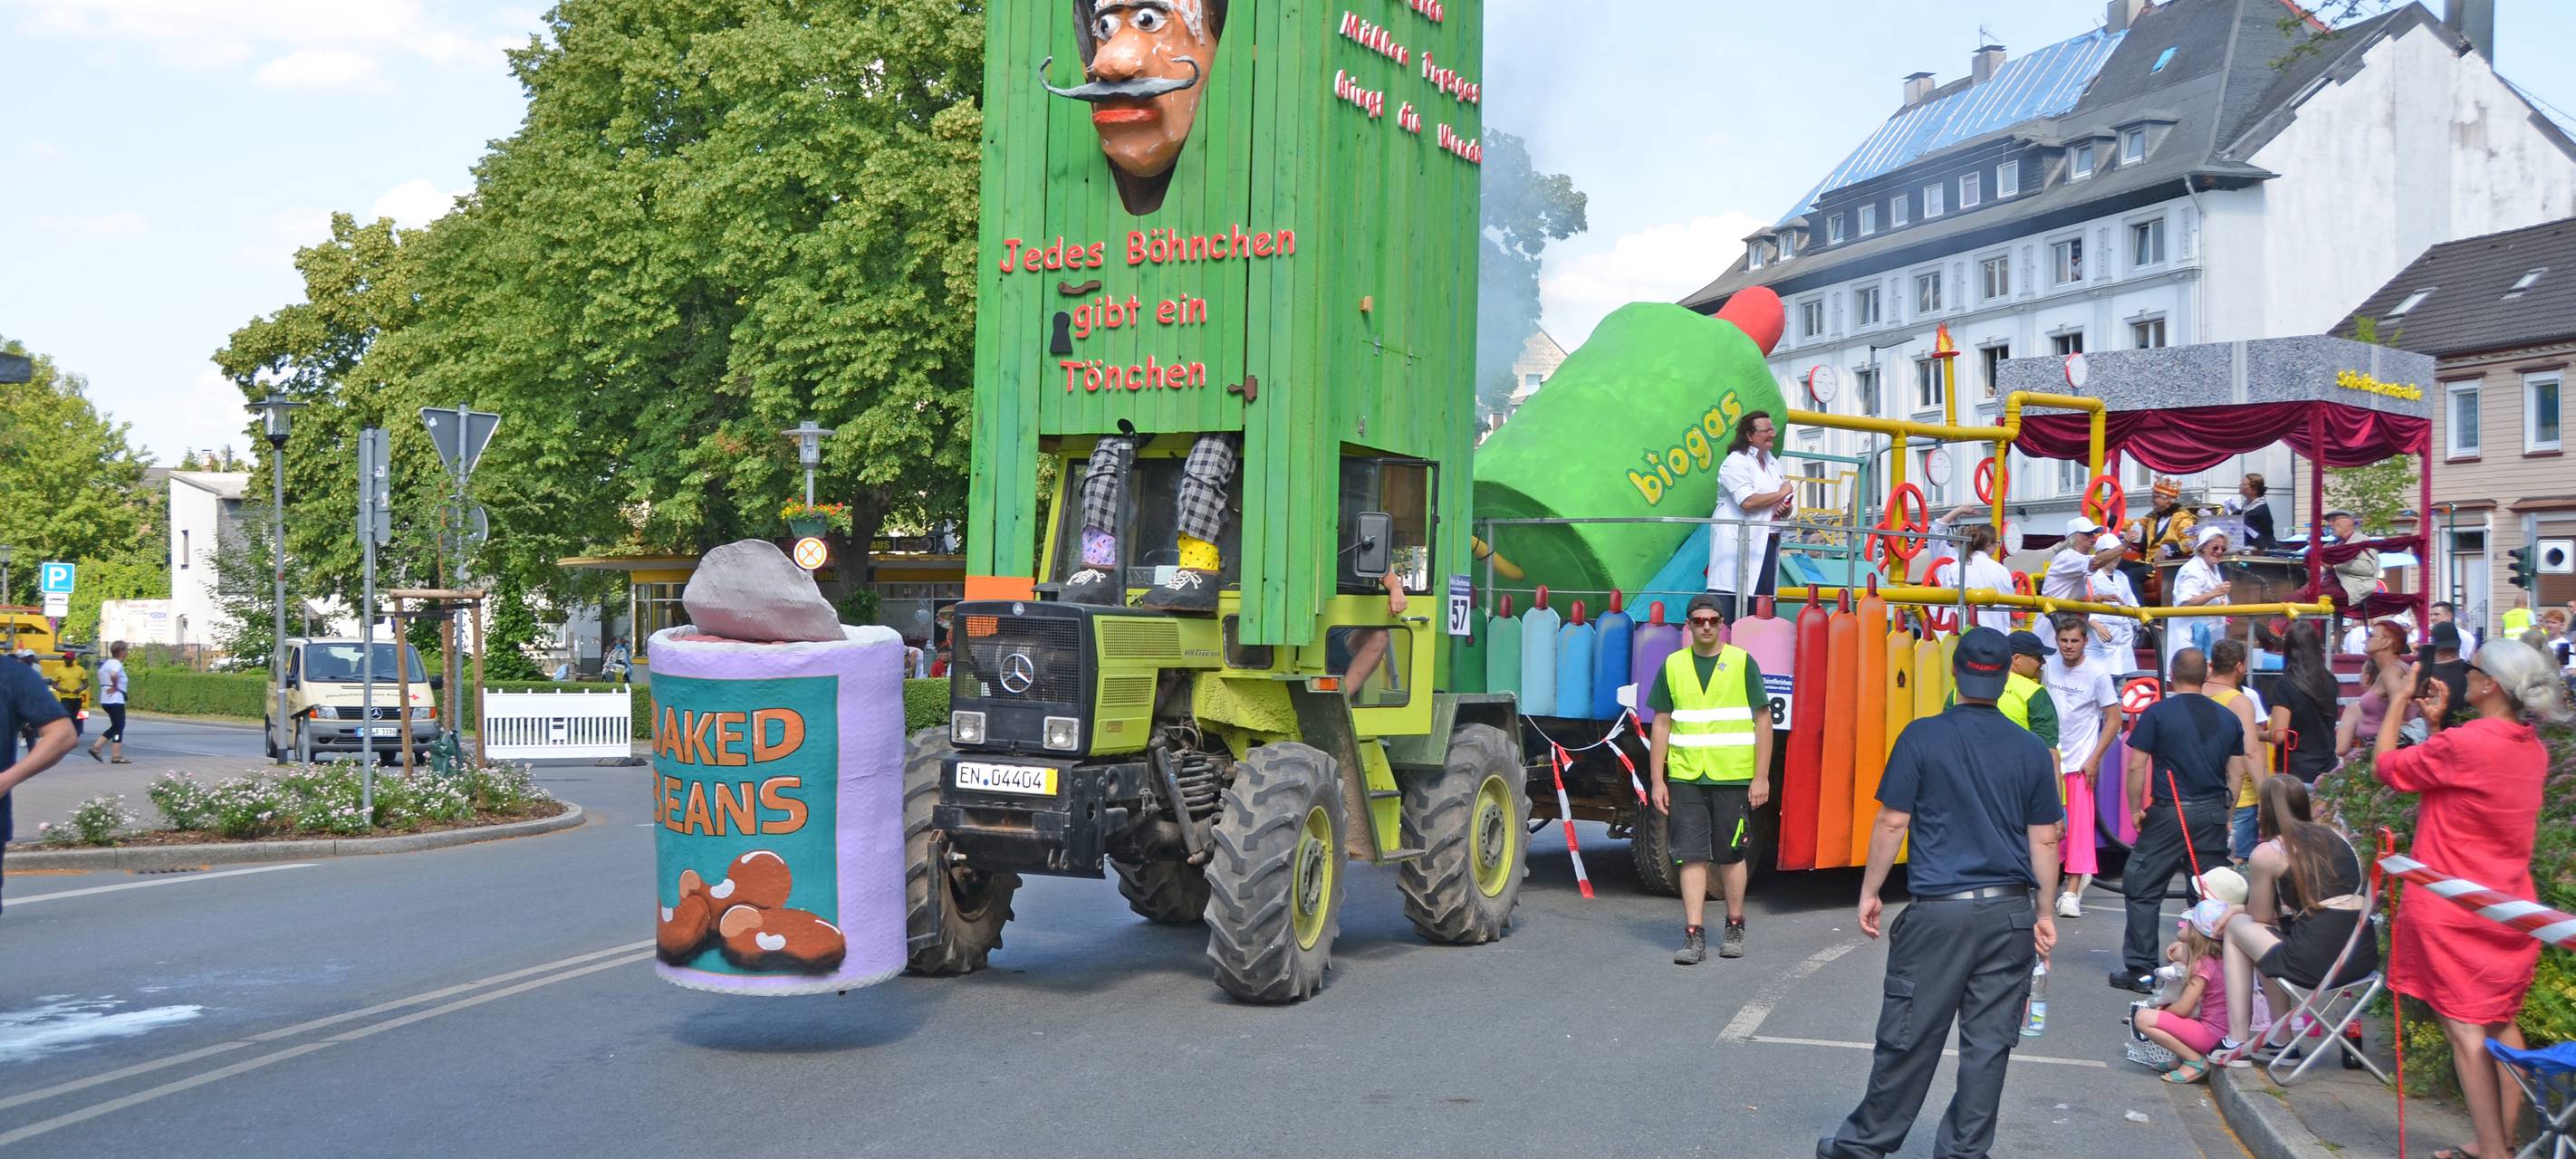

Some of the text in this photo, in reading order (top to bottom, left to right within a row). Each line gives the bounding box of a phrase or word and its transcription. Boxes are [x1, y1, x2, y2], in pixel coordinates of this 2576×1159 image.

[1339, 11, 1480, 105] Mühlen Pupsgas
[1334, 70, 1483, 165] bringt die Wende
[999, 224, 1296, 273] Jedes Böhnchen
[1073, 293, 1206, 339] gibt ein
[1060, 355, 1206, 392] Tönchen
[1627, 389, 1743, 506] biogas
[49, 567, 67, 589] P
[1452, 599, 1468, 630] 57
[960, 766, 1042, 789] EN 04404
